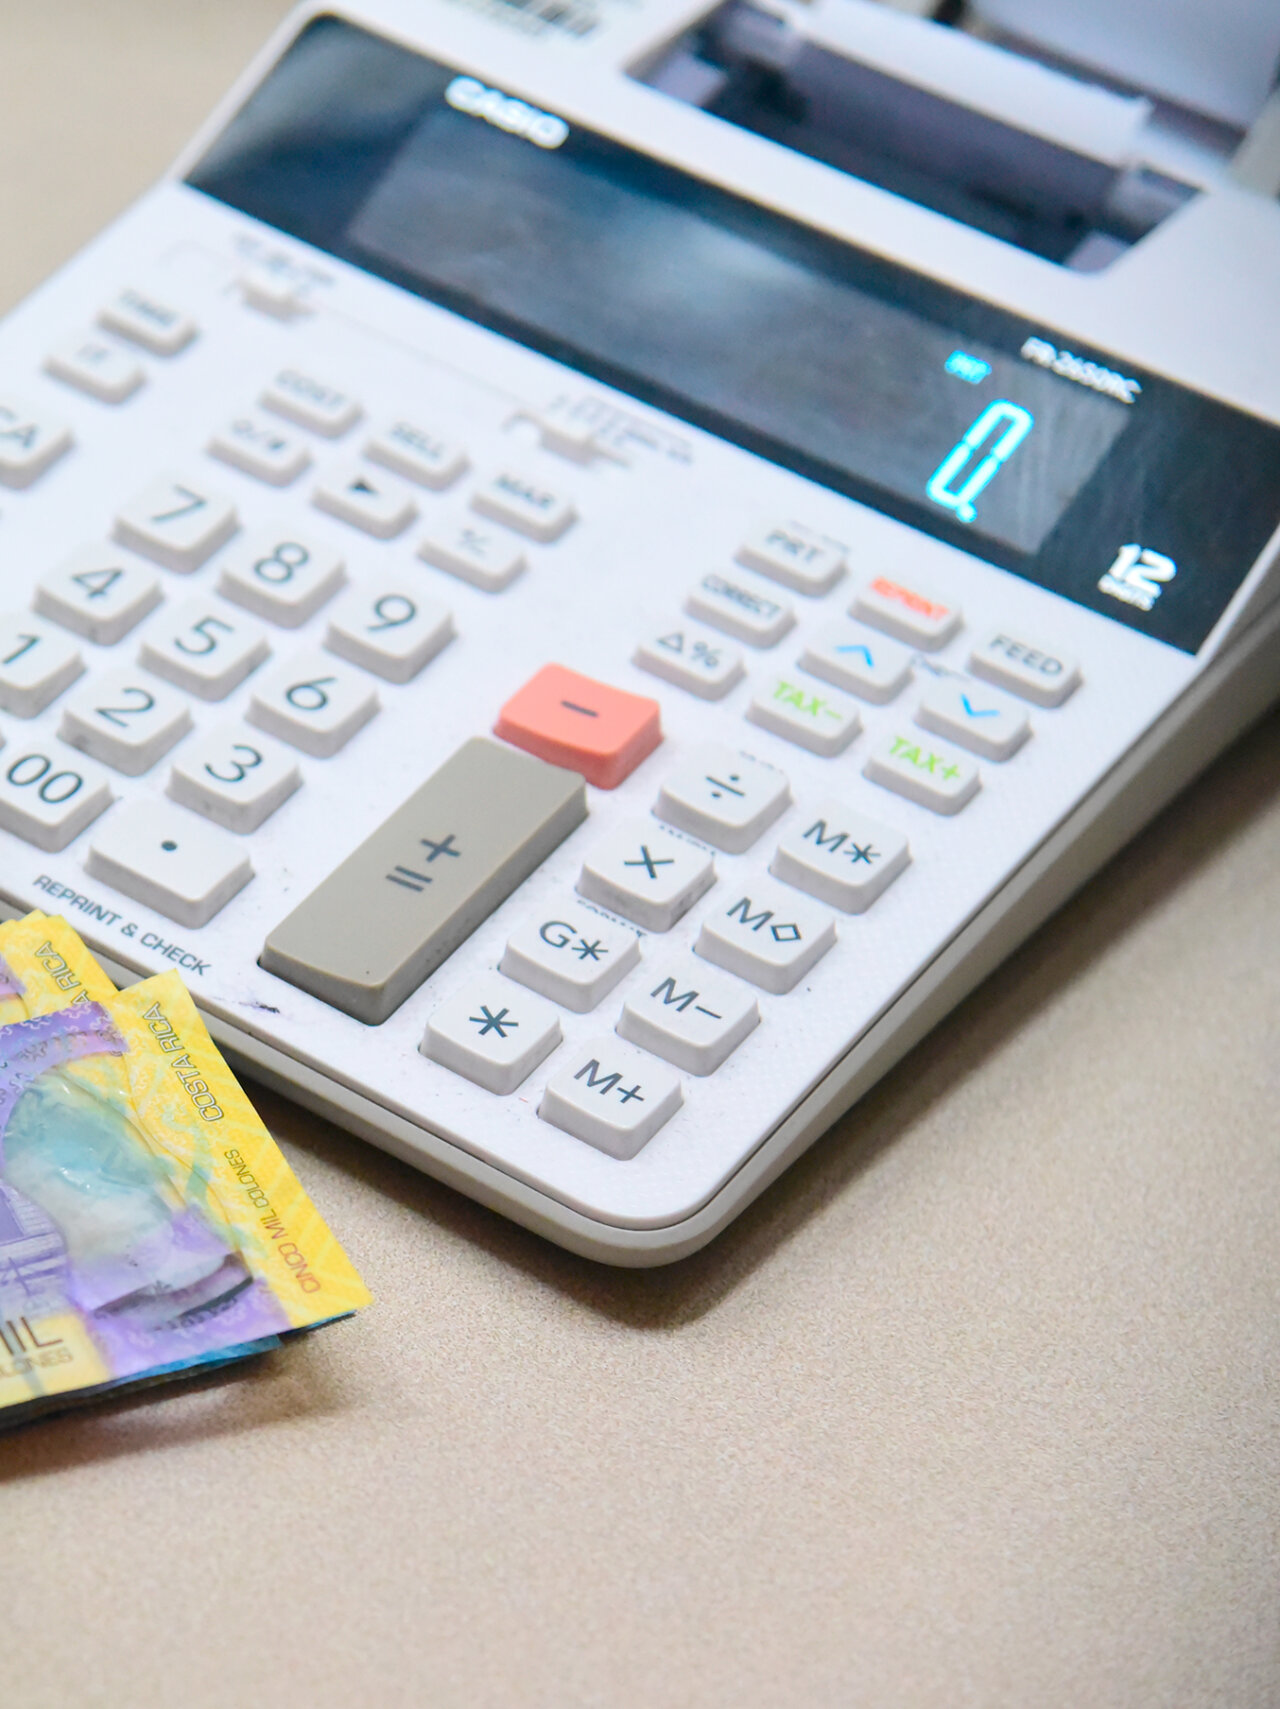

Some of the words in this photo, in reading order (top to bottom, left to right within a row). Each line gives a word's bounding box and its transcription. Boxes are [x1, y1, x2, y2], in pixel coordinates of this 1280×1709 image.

[445, 75, 570, 149] CASIO
[150, 483, 206, 523] 7
[71, 567, 123, 600] 4
[253, 541, 309, 584] 8
[1108, 542, 1177, 600] 12
[173, 615, 235, 656] 5
[366, 593, 418, 633] 9
[1, 634, 40, 666] 1
[989, 632, 1064, 677] FEED
[95, 687, 156, 728] 2
[285, 676, 338, 711] 6
[6, 754, 83, 804] 00
[204, 744, 263, 783] 3
[33, 874, 123, 926] REPRINT
[120, 922, 138, 938] &
[140, 932, 212, 976] CHECK
[35, 941, 81, 991] RICA
[143, 1002, 185, 1053] RICA
[172, 1054, 224, 1122] COSTA
[574, 1059, 645, 1104] M+
[224, 1149, 270, 1208] COLONES
[260, 1208, 289, 1239] MIL
[278, 1242, 321, 1294] CINCO
